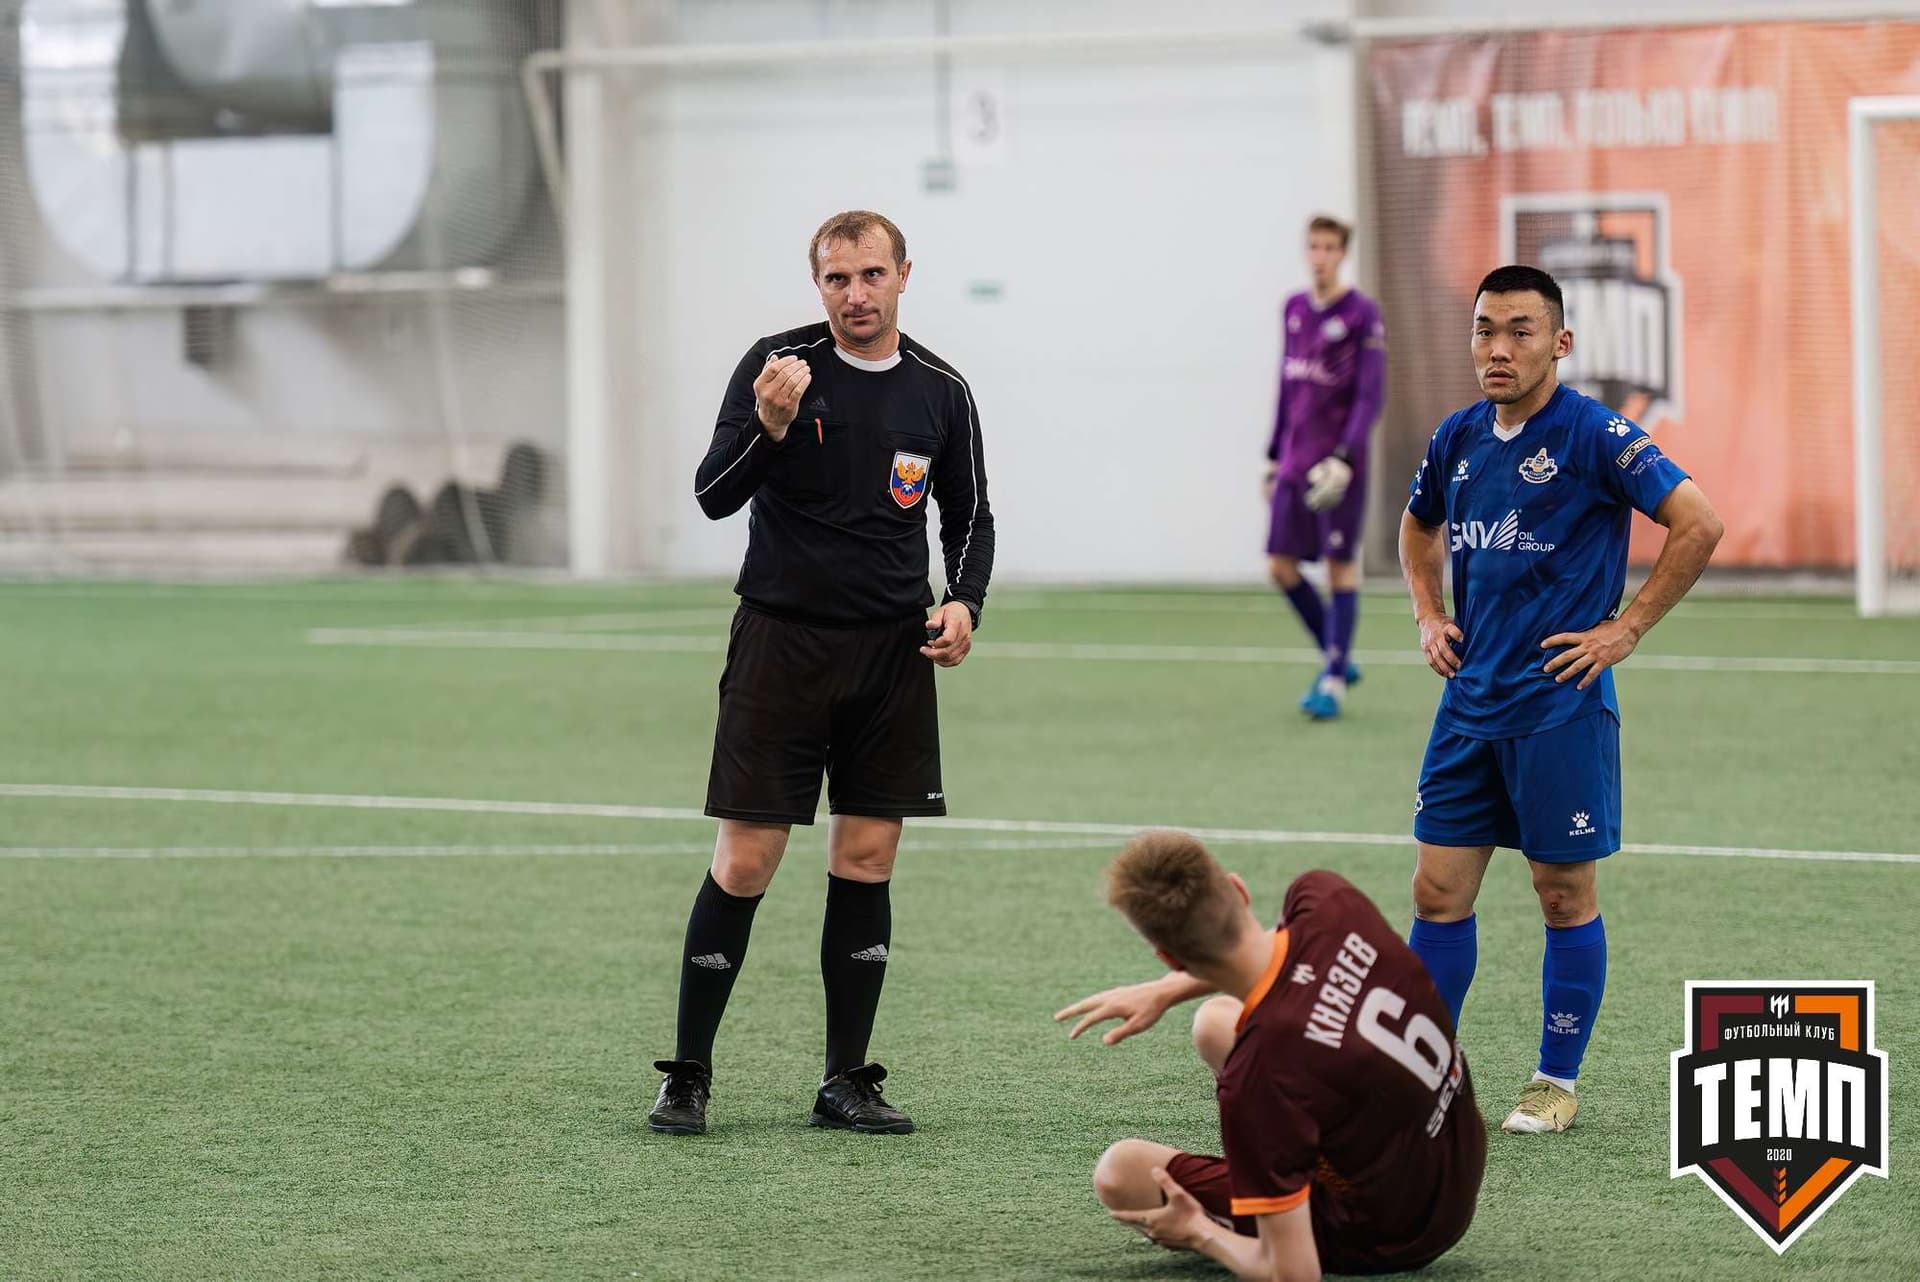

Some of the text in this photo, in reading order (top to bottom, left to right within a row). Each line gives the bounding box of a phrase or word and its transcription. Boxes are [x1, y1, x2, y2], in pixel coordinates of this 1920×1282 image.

[1518, 532, 1535, 541] OIL
[1518, 542, 1555, 552] GROUP
[1569, 826, 1596, 837] KELME
[1304, 932, 1378, 1049] КНЯЗЕВ
[1548, 1023, 1580, 1035] KELME
[1356, 986, 1452, 1092] 6
